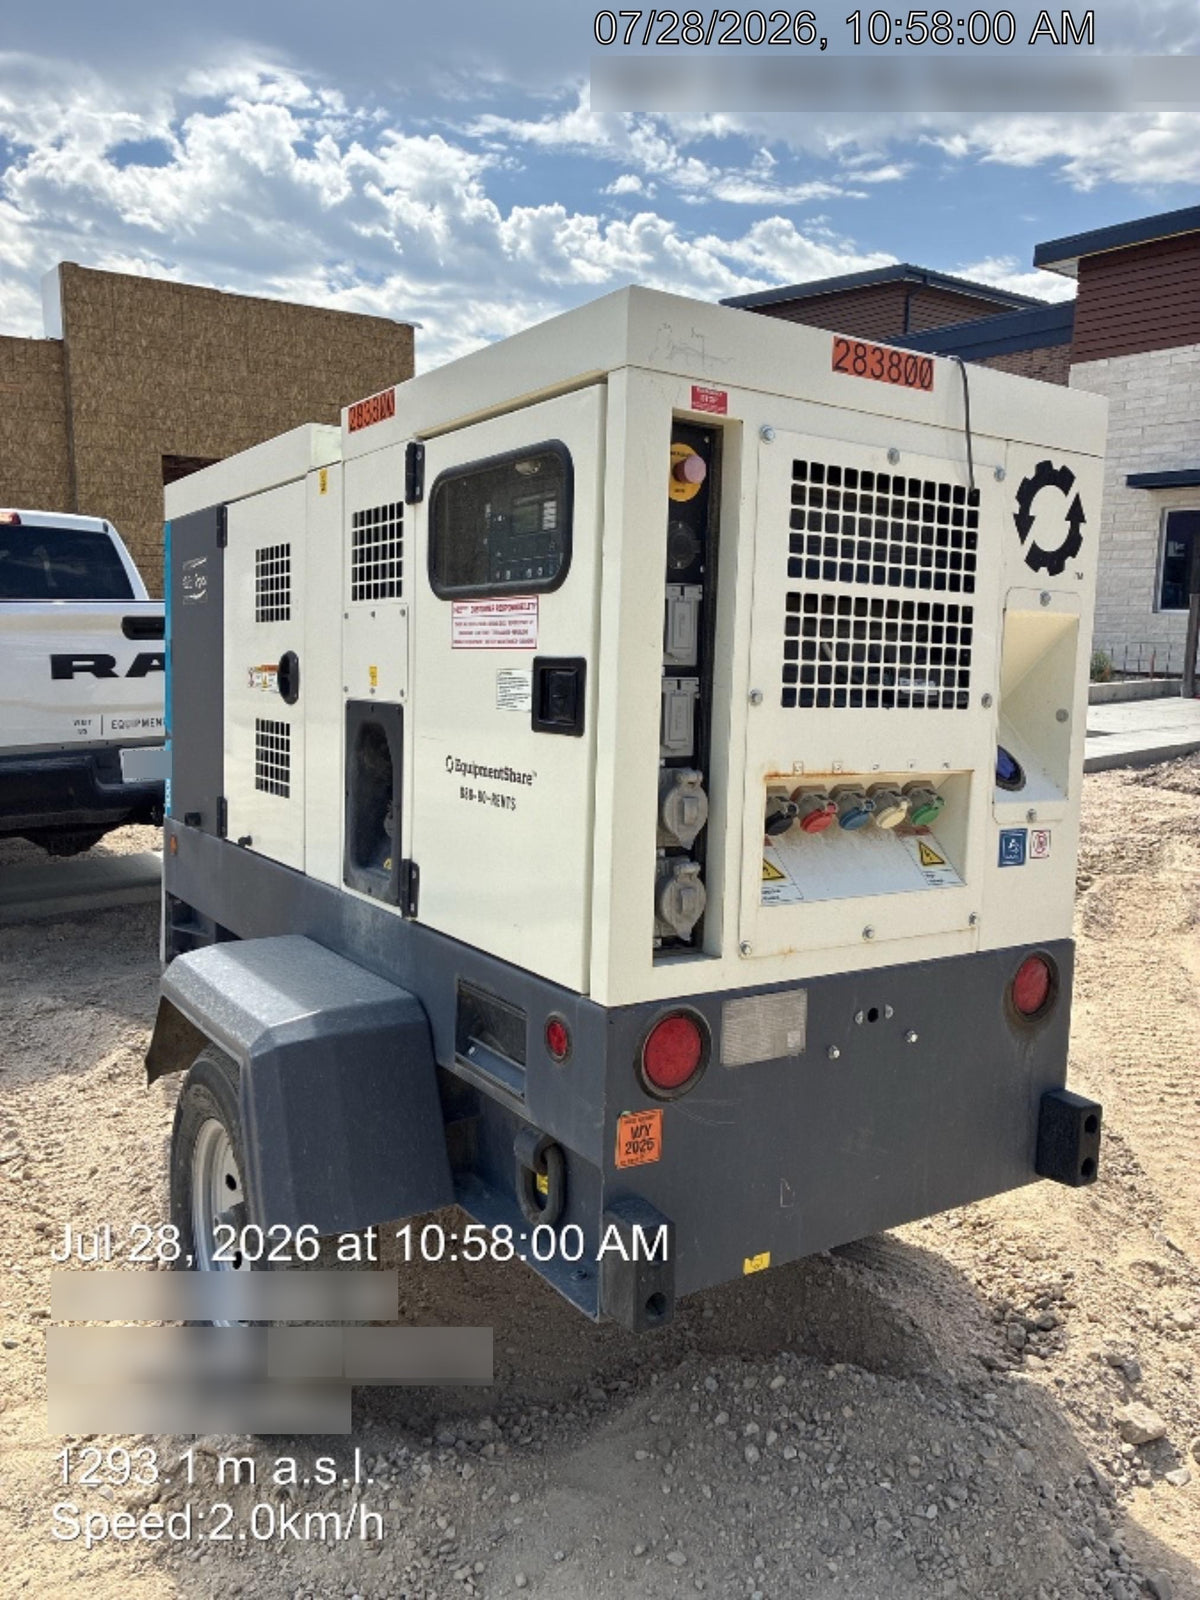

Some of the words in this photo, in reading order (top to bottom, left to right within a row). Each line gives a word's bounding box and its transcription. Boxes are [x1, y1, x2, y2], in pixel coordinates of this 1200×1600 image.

[834, 338, 933, 390] 283800
[50, 653, 165, 680] RA
[111, 717, 164, 730] EQUIPMEN
[454, 757, 533, 786] EquipmentShare
[630, 1123, 652, 1140] WY
